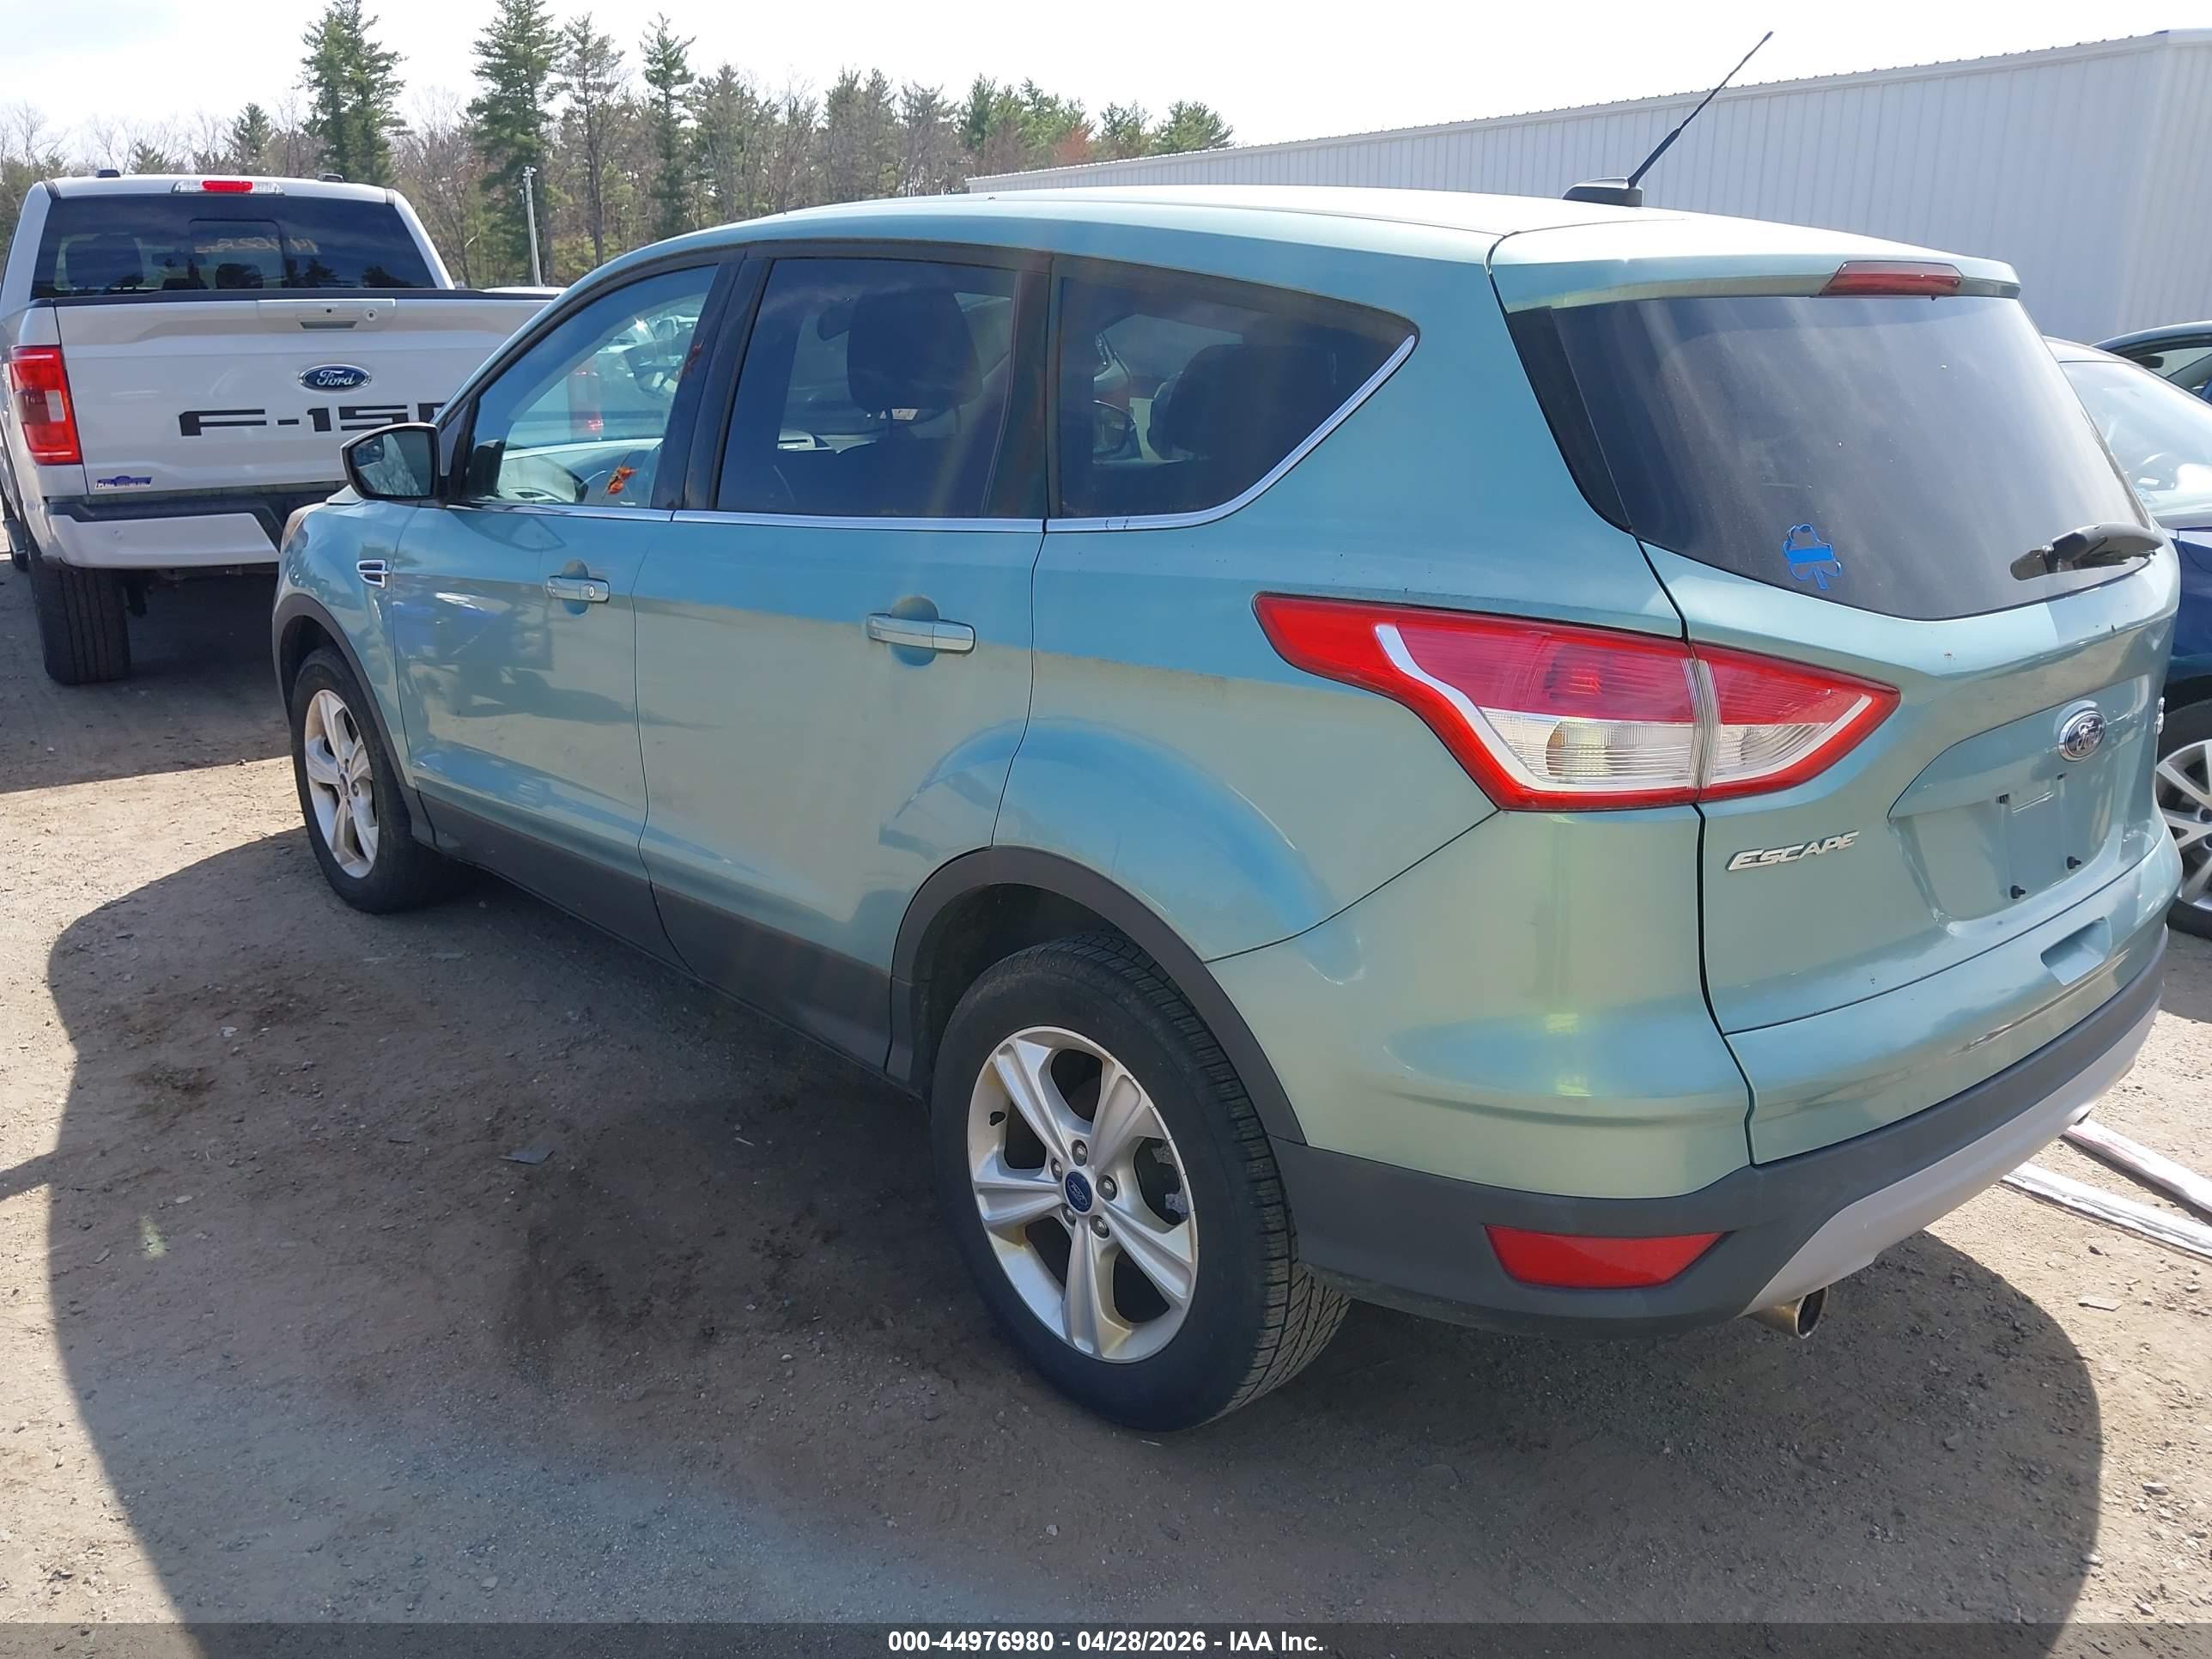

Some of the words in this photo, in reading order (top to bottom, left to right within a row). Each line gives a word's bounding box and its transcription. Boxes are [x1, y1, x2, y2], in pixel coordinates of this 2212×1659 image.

[316, 369, 356, 386] Ford
[2075, 718, 2104, 752] Ford
[1725, 830, 1859, 871] ESCAPE
